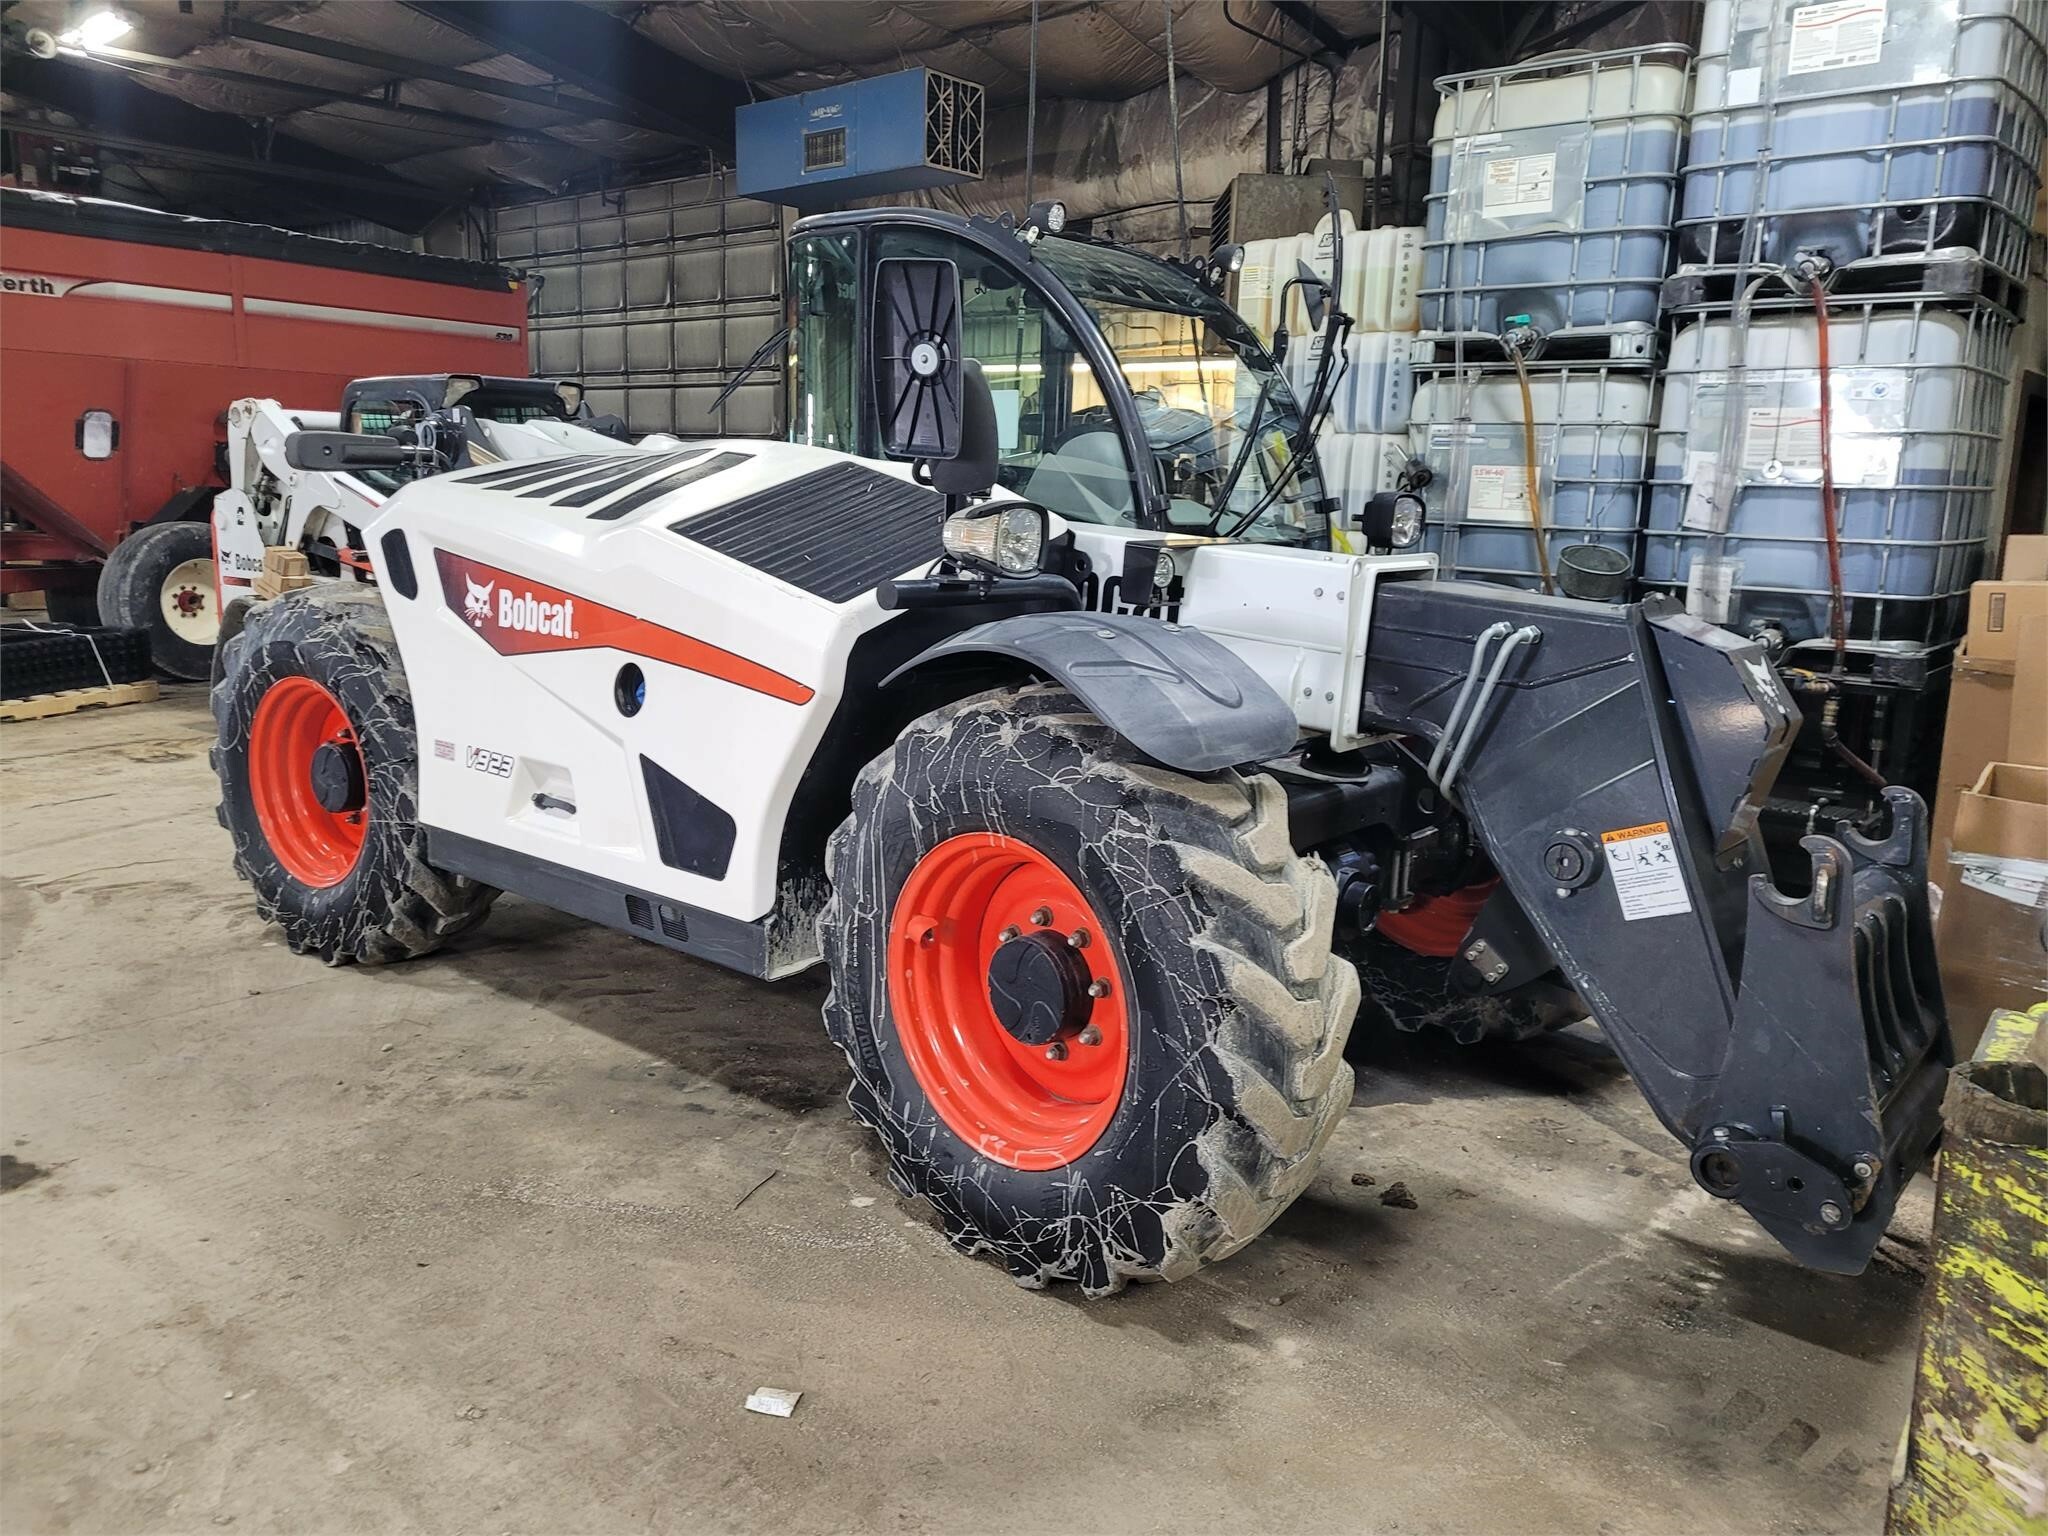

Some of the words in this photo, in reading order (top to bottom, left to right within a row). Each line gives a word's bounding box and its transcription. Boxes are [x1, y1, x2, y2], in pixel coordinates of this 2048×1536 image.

[0, 274, 55, 295] erth
[498, 588, 574, 639] Bobcat
[466, 745, 515, 778] V923
[1617, 824, 1665, 840] WARNING
